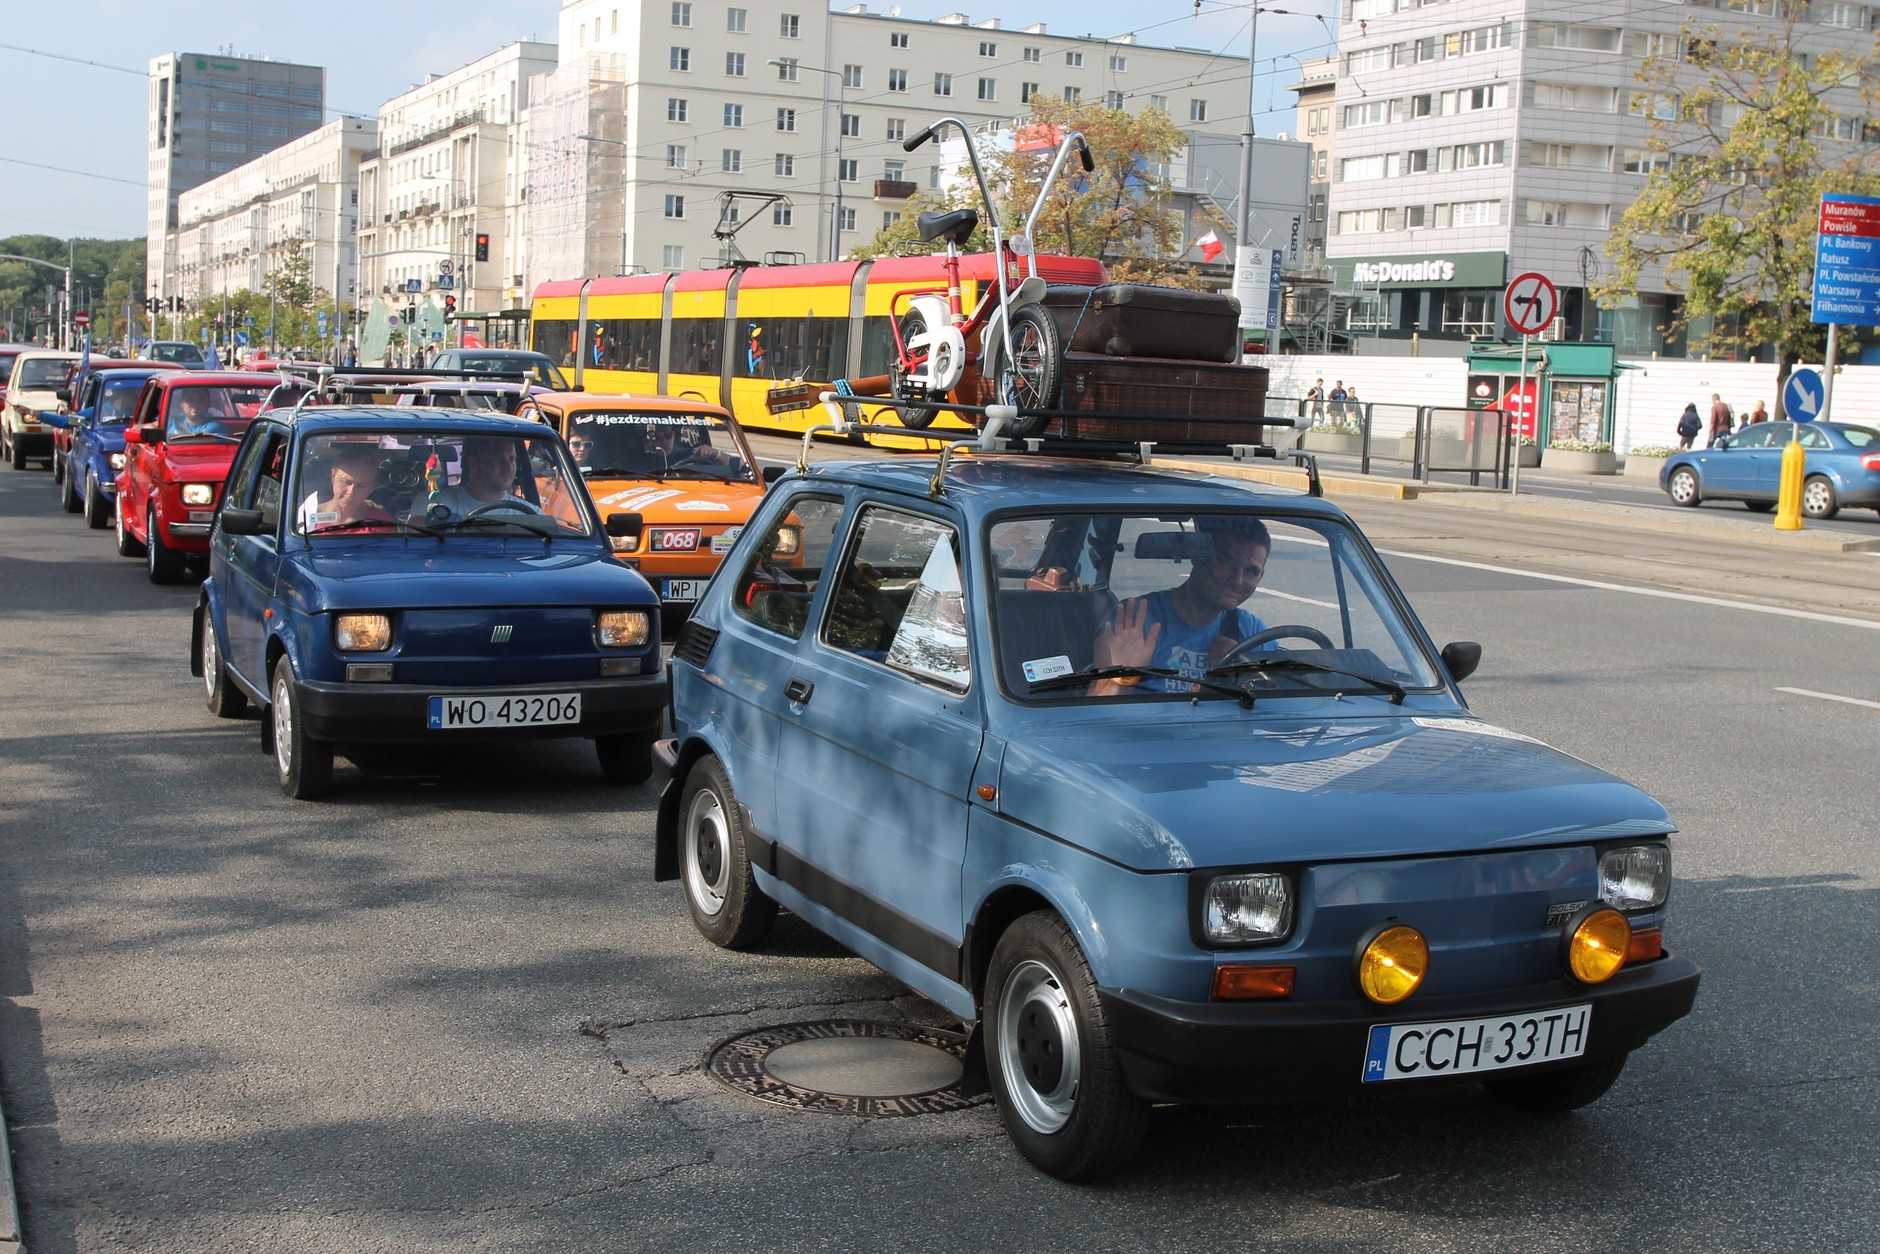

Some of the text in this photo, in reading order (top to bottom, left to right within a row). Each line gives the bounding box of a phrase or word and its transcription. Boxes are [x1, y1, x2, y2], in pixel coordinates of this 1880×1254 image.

[1825, 203, 1866, 217] Muranów
[1824, 220, 1857, 233] Powiśle
[1822, 236, 1872, 253] Pl. Bankowy
[1821, 252, 1850, 264] Ratusz
[1353, 260, 1455, 282] McDonald's
[1820, 269, 1830, 280] Pl.
[1818, 284, 1862, 299] Warszawy
[1817, 300, 1865, 314] Filharmonia
[596, 414, 715, 427] #jezdzemaluchem
[662, 532, 694, 548] 068
[448, 700, 486, 724] WO
[496, 696, 577, 724] 43206
[1368, 1010, 1586, 1073] PL CCH 33TH
